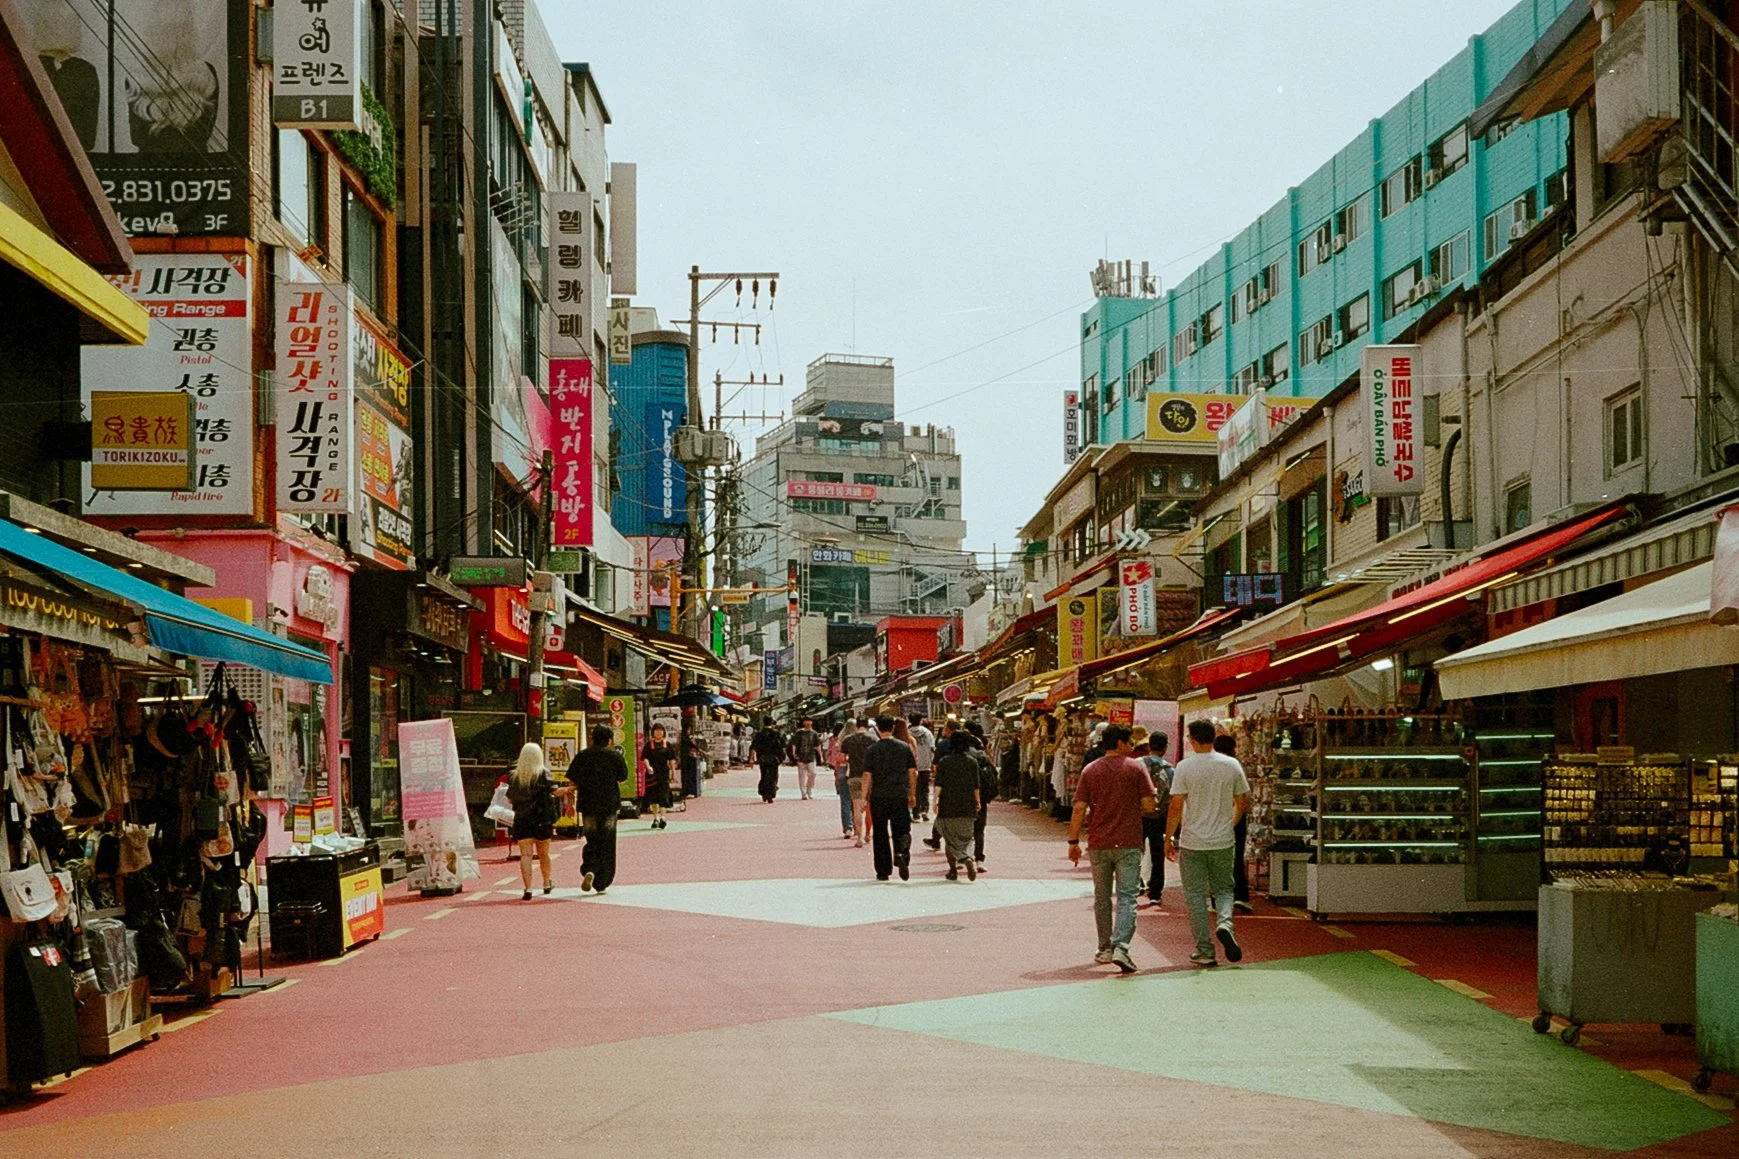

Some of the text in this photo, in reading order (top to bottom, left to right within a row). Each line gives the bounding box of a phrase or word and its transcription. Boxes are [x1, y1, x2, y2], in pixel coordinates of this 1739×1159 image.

[280, 62, 349, 86] 프렌즈
[301, 99, 327, 119] B1
[204, 214, 228, 231] 3F
[145, 267, 231, 295] 사격장
[173, 303, 226, 317] Range
[173, 328, 219, 352] 권총
[286, 291, 324, 393] 리얼샷
[612, 311, 630, 354] 사진
[180, 355, 212, 365] Pistol
[327, 305, 339, 401] SHOOTING
[555, 368, 590, 401] 홍대
[328, 413, 339, 471] RANGE
[1066, 408, 1077, 461] 호미화방
[102, 451, 178, 463] TORIKIZOKU
[286, 401, 324, 503] 사격장
[560, 405, 585, 523] 반지공방
[564, 528, 579, 539] 2F
